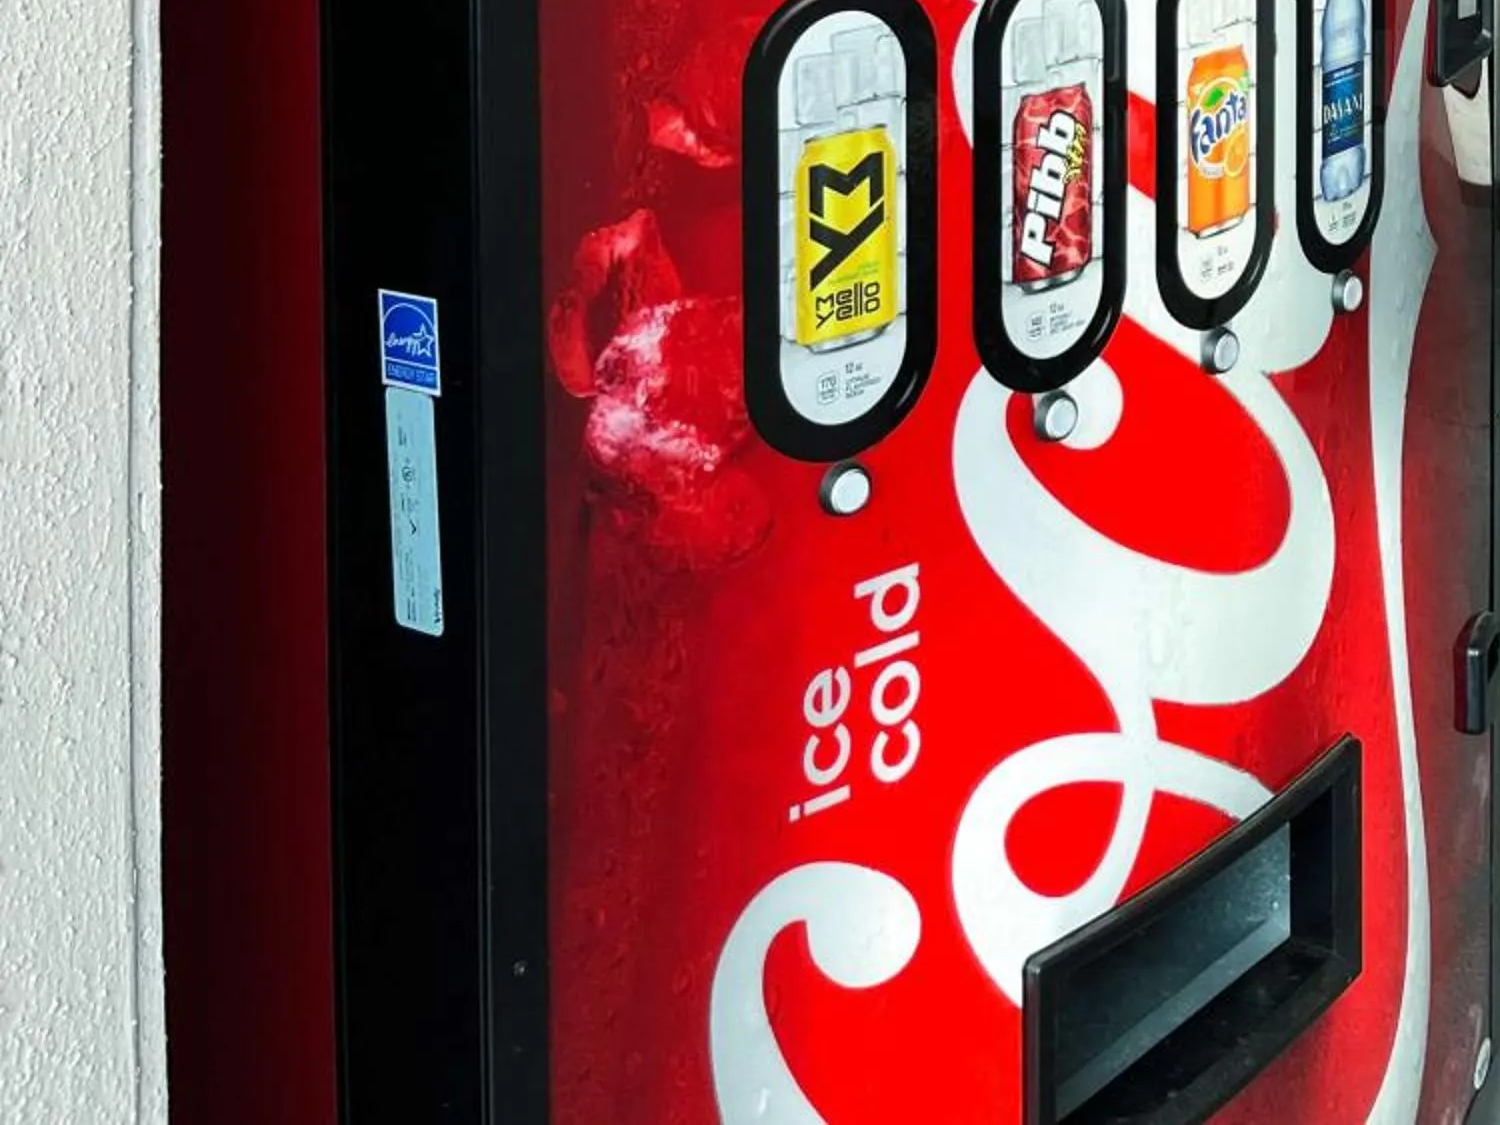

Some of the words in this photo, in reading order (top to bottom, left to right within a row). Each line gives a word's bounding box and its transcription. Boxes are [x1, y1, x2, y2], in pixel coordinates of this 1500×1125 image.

[1021, 110, 1076, 266] Pibb
[1191, 91, 1247, 164] Fanta
[788, 666, 851, 823] ice
[853, 561, 921, 784] cold
